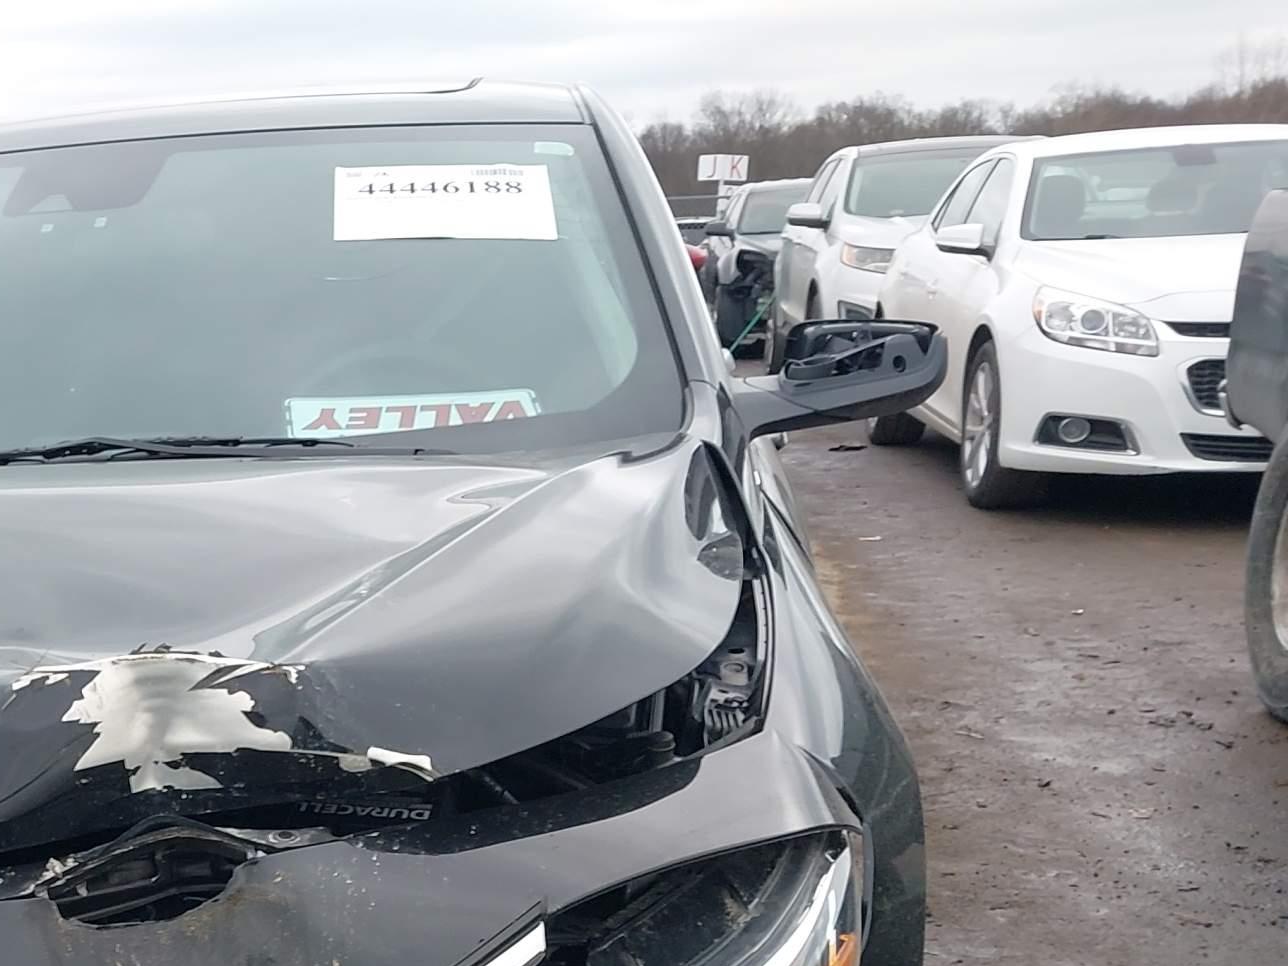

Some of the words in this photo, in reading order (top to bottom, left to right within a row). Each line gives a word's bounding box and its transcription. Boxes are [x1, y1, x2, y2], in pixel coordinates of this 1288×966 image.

[706, 155, 717, 178] J
[730, 155, 744, 178] K
[357, 180, 523, 195] 44446188
[301, 400, 528, 431] VALLEY
[298, 801, 432, 820] DURACELL
